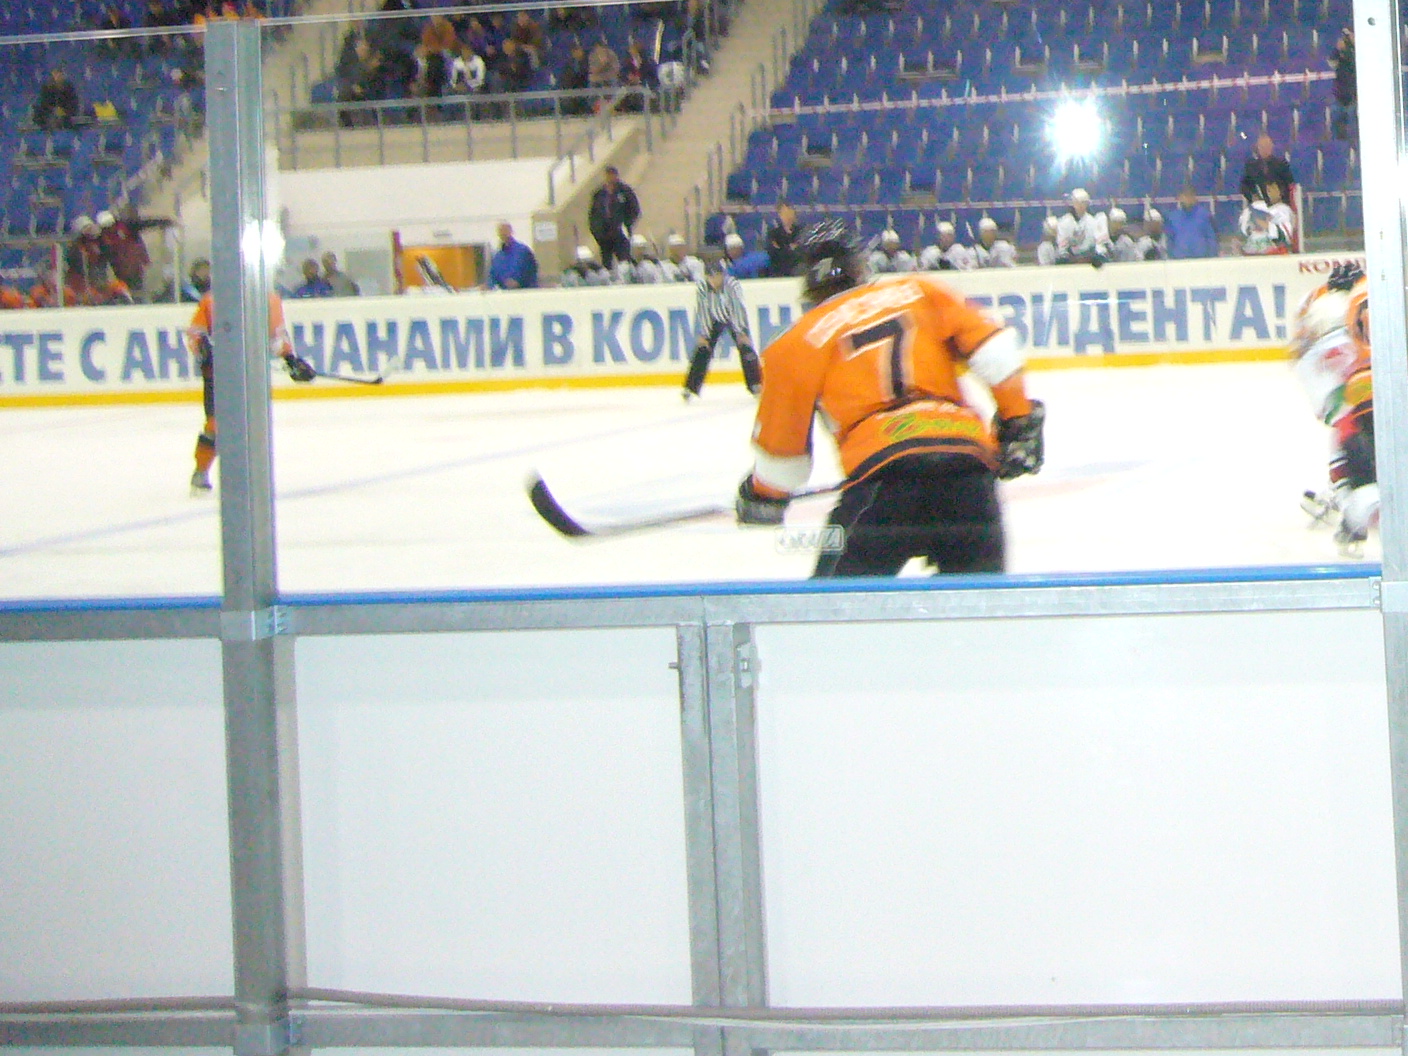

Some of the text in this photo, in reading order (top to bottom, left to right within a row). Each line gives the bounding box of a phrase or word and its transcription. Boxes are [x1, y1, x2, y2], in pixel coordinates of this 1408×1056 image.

[0, 332, 64, 381] ТЕ
[80, 329, 106, 381] С
[542, 312, 574, 364] В
[842, 310, 918, 400] 7
